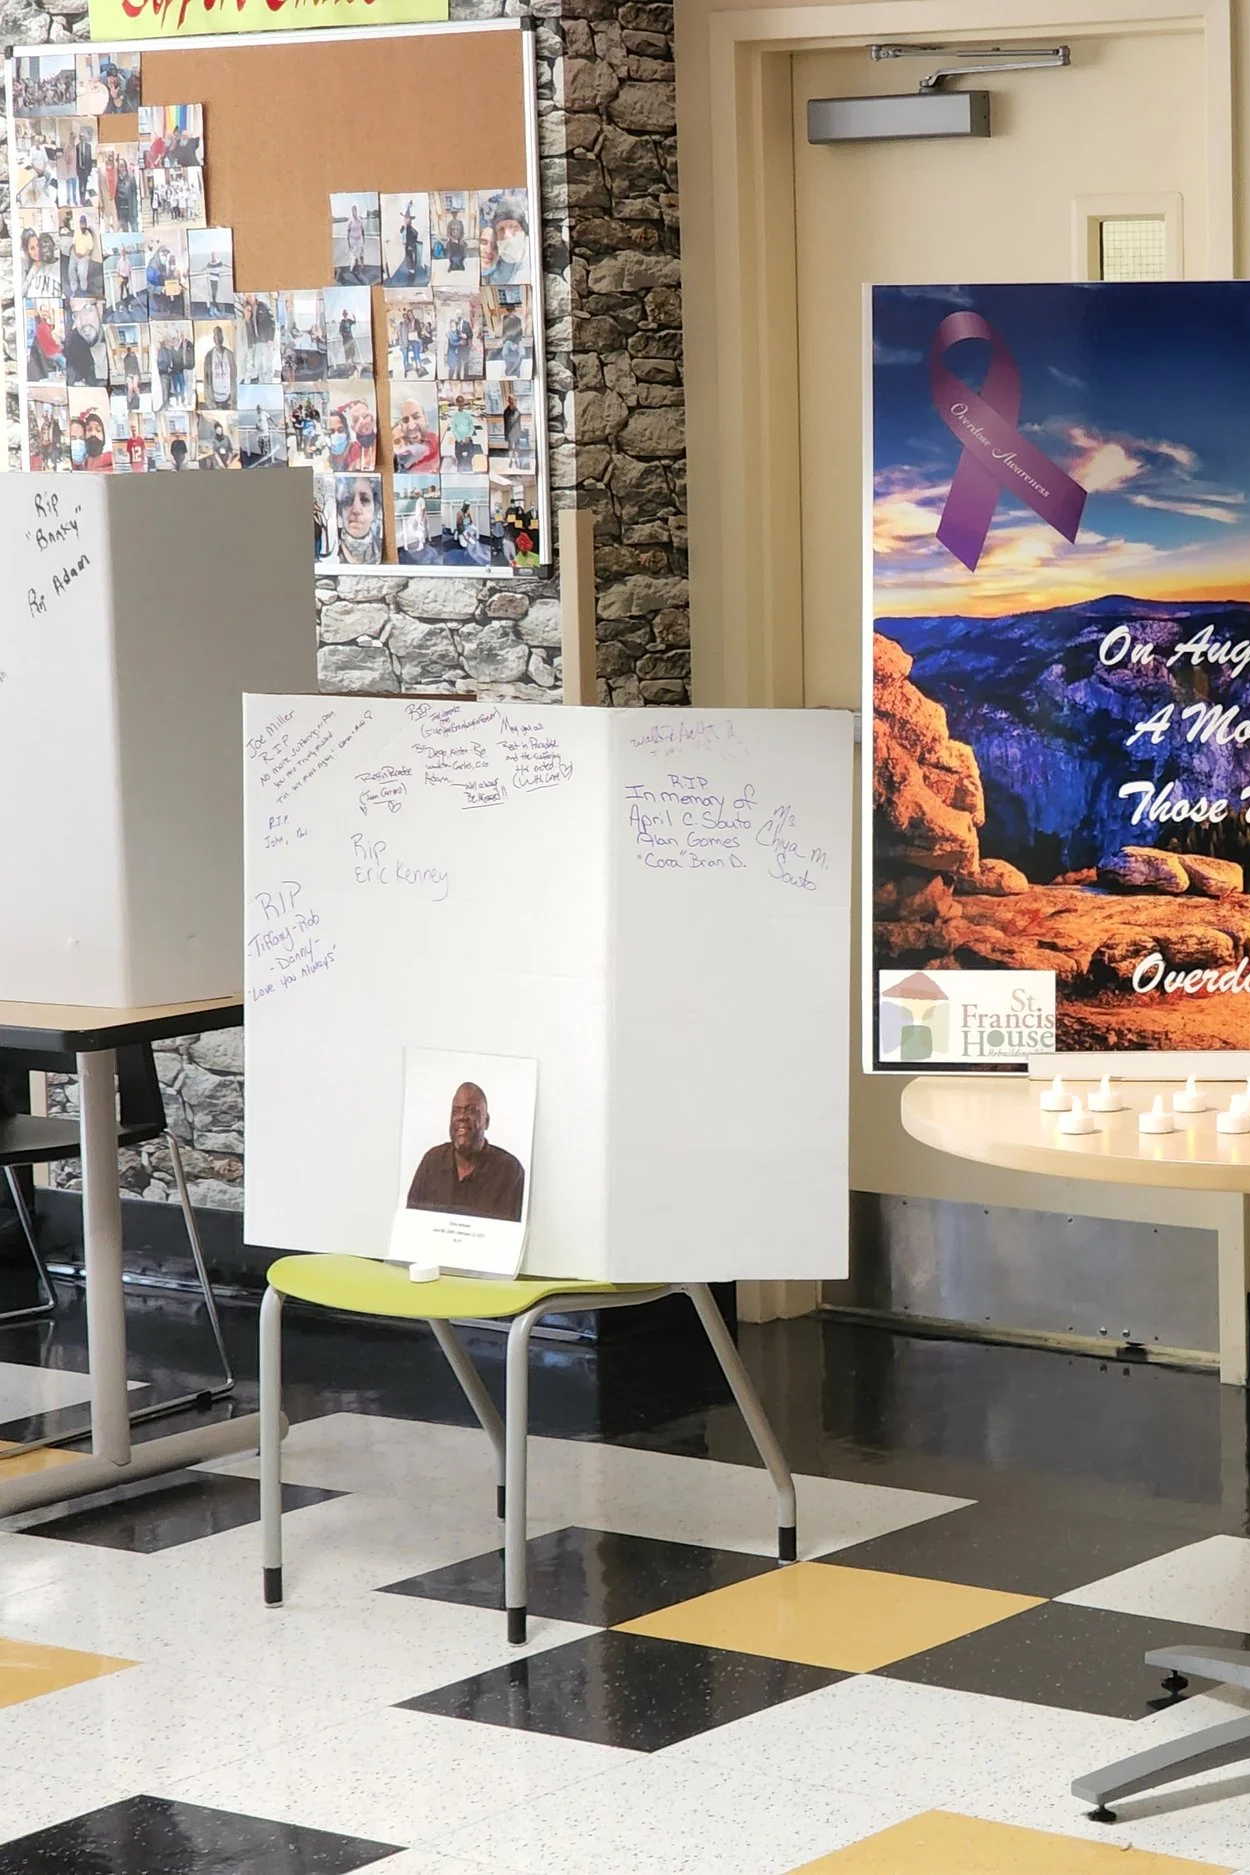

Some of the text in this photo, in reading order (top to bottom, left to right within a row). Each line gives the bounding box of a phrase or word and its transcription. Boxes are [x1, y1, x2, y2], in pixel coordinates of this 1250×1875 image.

[950, 402, 1050, 498] Overdose Awareness
[1099, 625, 1154, 666] On
[1126, 704, 1174, 746] A
[625, 783, 758, 822] In memory of
[1118, 781, 1228, 825] Those
[255, 880, 302, 921] RIP
[961, 1004, 1055, 1030] Francis
[1011, 988, 1043, 1014] St.
[961, 1030, 1055, 1057] House
